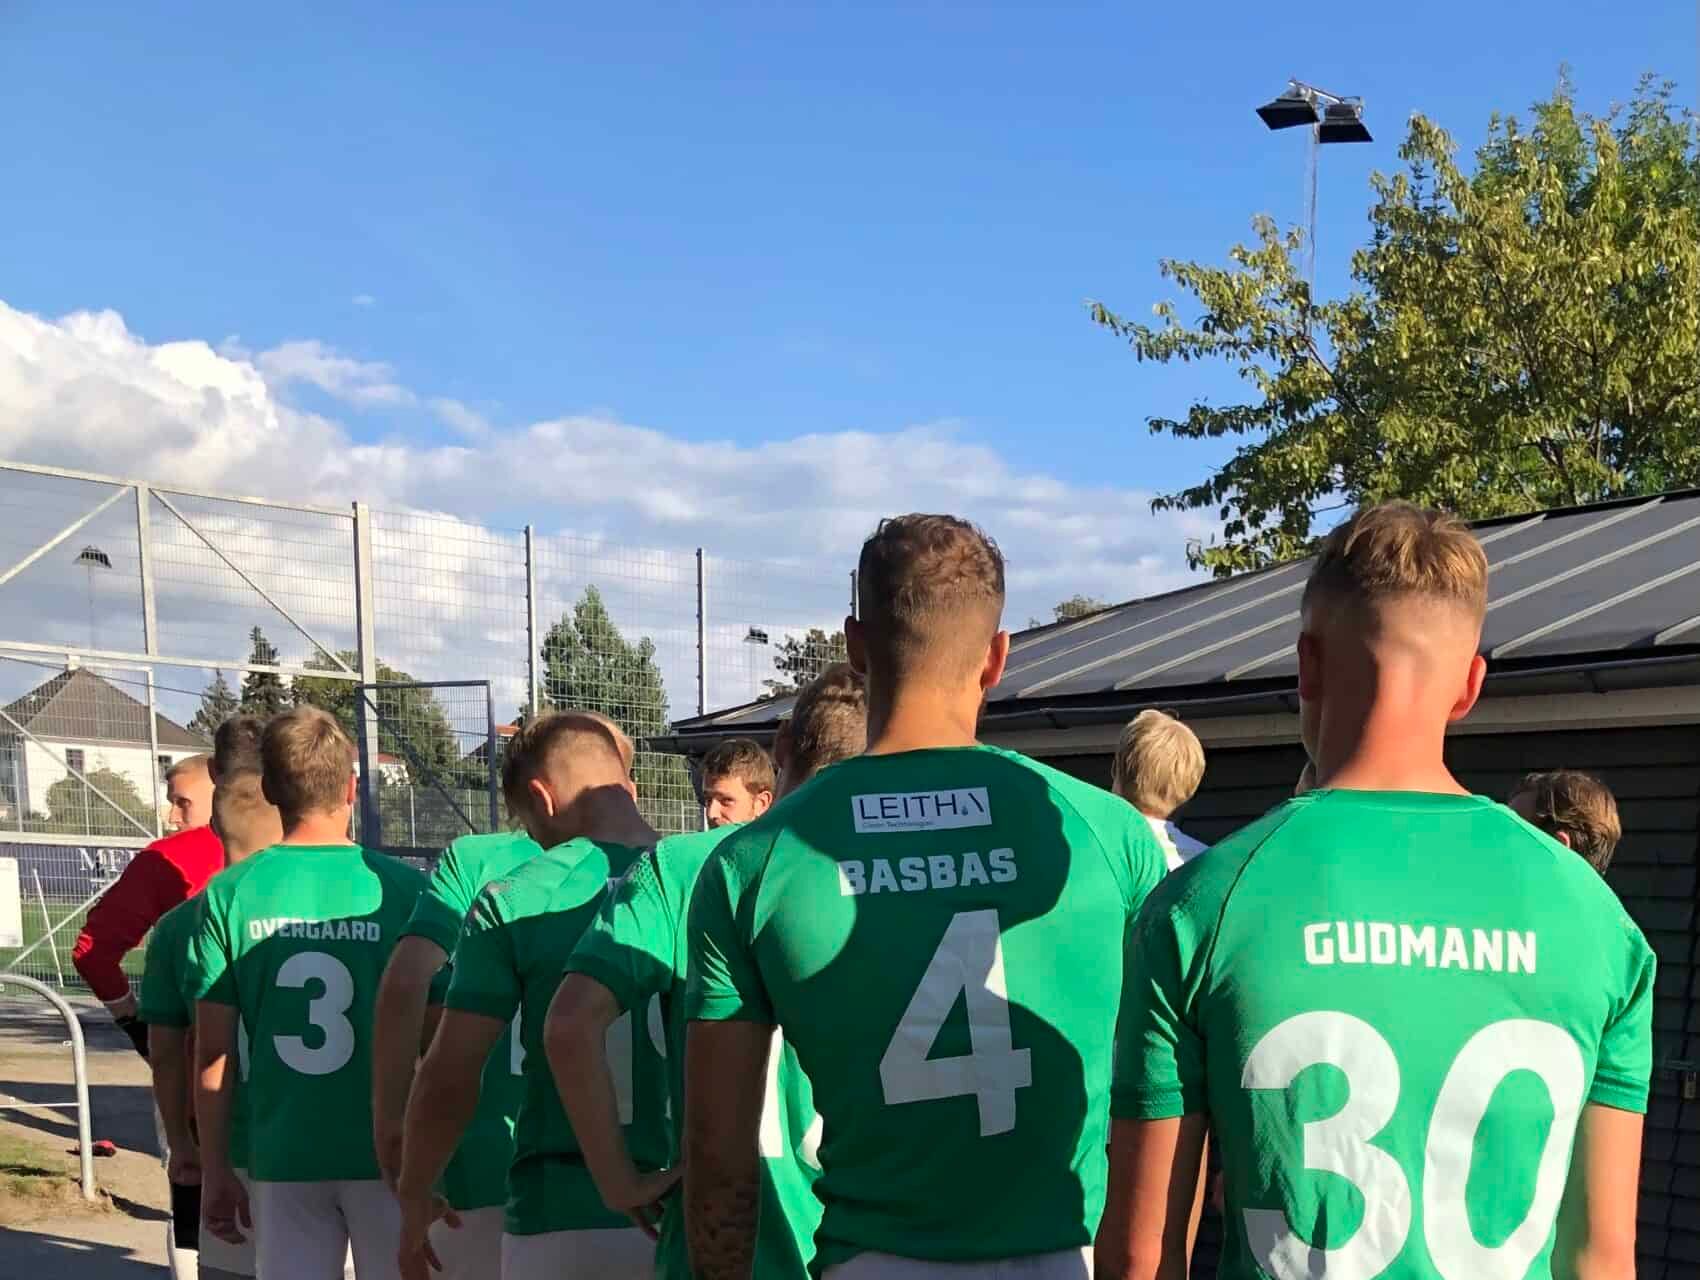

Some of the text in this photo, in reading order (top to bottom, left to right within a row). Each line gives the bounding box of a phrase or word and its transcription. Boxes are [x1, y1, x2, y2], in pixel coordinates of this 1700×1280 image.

[837, 847, 1018, 897] BASBAS
[1303, 922, 1538, 974] GUDMANN
[272, 950, 356, 1076] 3
[879, 908, 1032, 1137] 4
